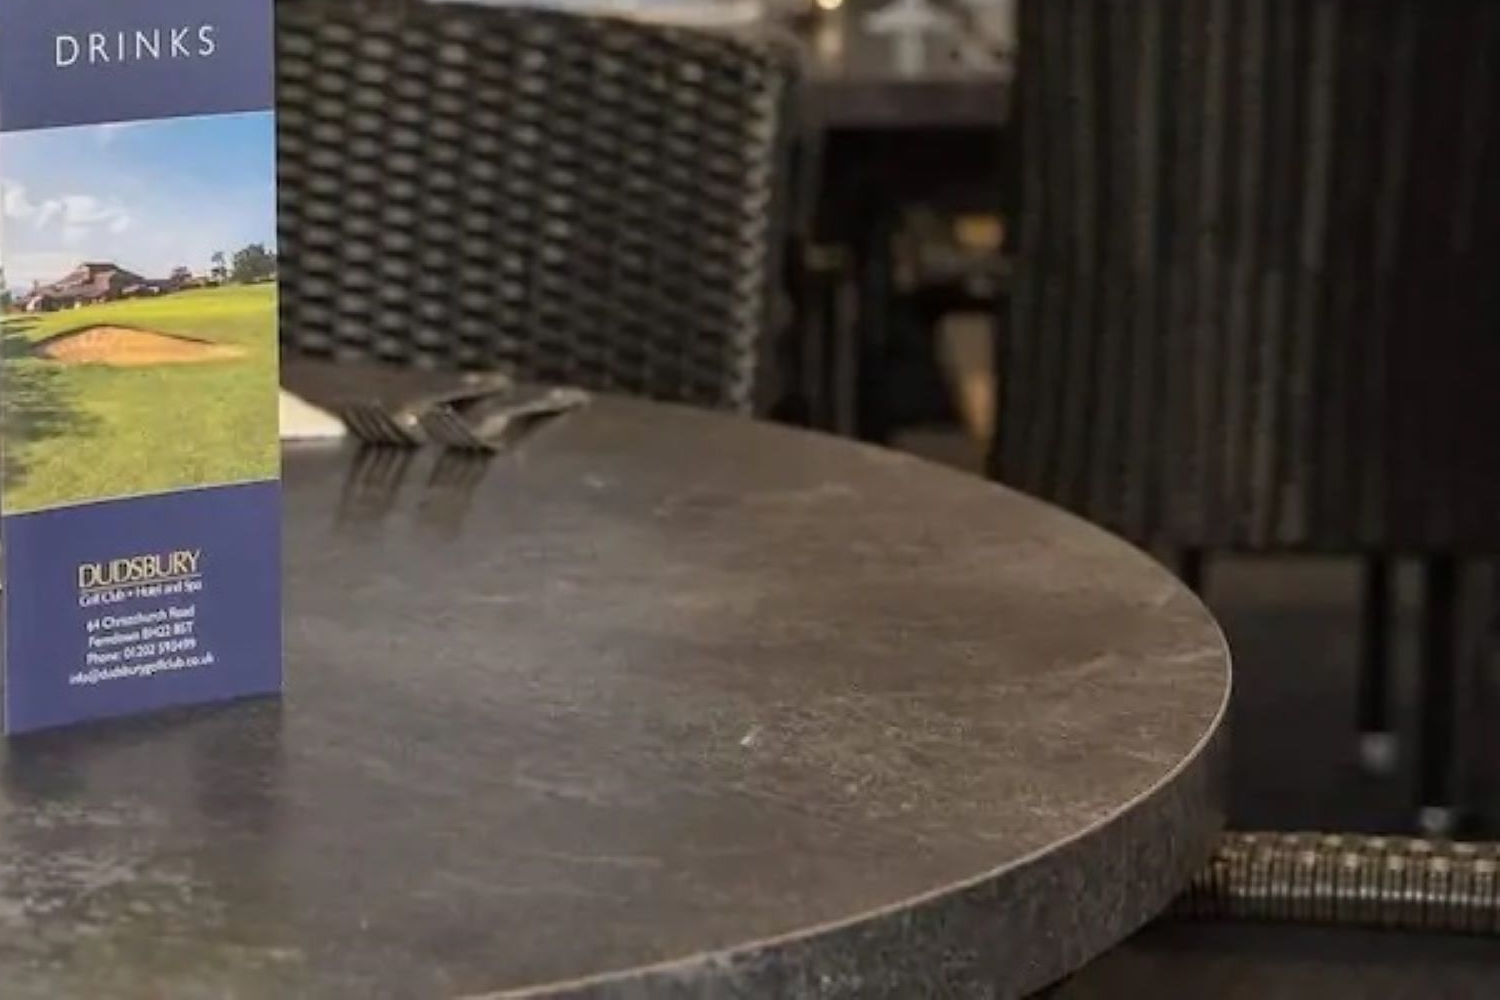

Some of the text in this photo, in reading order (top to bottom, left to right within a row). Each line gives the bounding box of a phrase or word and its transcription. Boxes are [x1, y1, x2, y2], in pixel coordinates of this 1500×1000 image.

[55, 26, 216, 67] DRINKS
[78, 549, 201, 588] DUDSBURY
[101, 591, 126, 604] Club
[164, 581, 182, 594] and
[184, 581, 202, 593] Spa
[169, 604, 195, 618] Road
